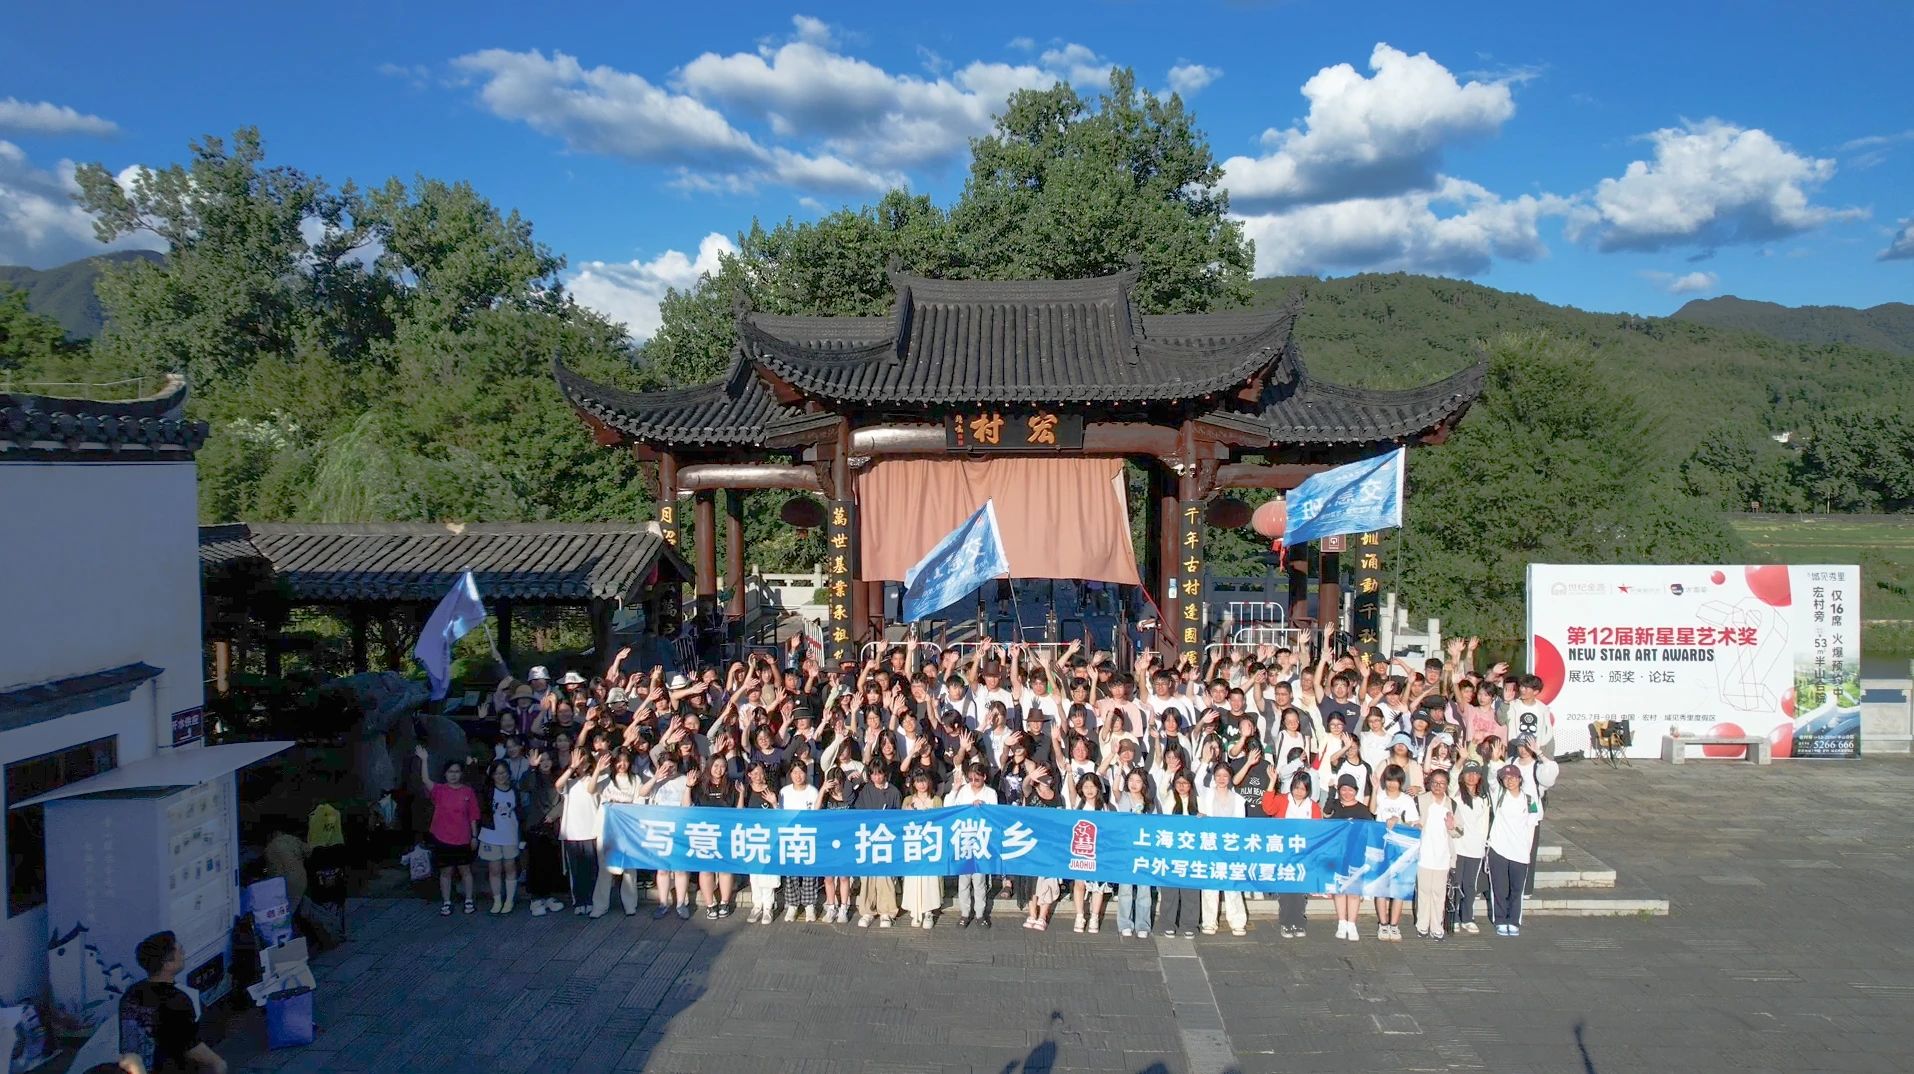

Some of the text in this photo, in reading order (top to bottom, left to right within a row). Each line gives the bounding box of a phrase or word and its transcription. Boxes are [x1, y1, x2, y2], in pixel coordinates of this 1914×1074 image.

[969, 413, 1059, 444] 宏村
[1567, 626, 1757, 646] 第12届新星星艺术奖
[1568, 648, 1715, 661] NEW STAR ART AWARDS
[1813, 740, 1836, 749] 5266
[1838, 740, 1854, 749] 666
[640, 818, 1038, 866] 写意皖南·拾韵徽乡
[1133, 828, 1307, 854] 上海交慧艺术高中
[1070, 860, 1095, 870] JIAOHUI
[1132, 856, 1307, 882] 户外写生课堂《夏绘》
